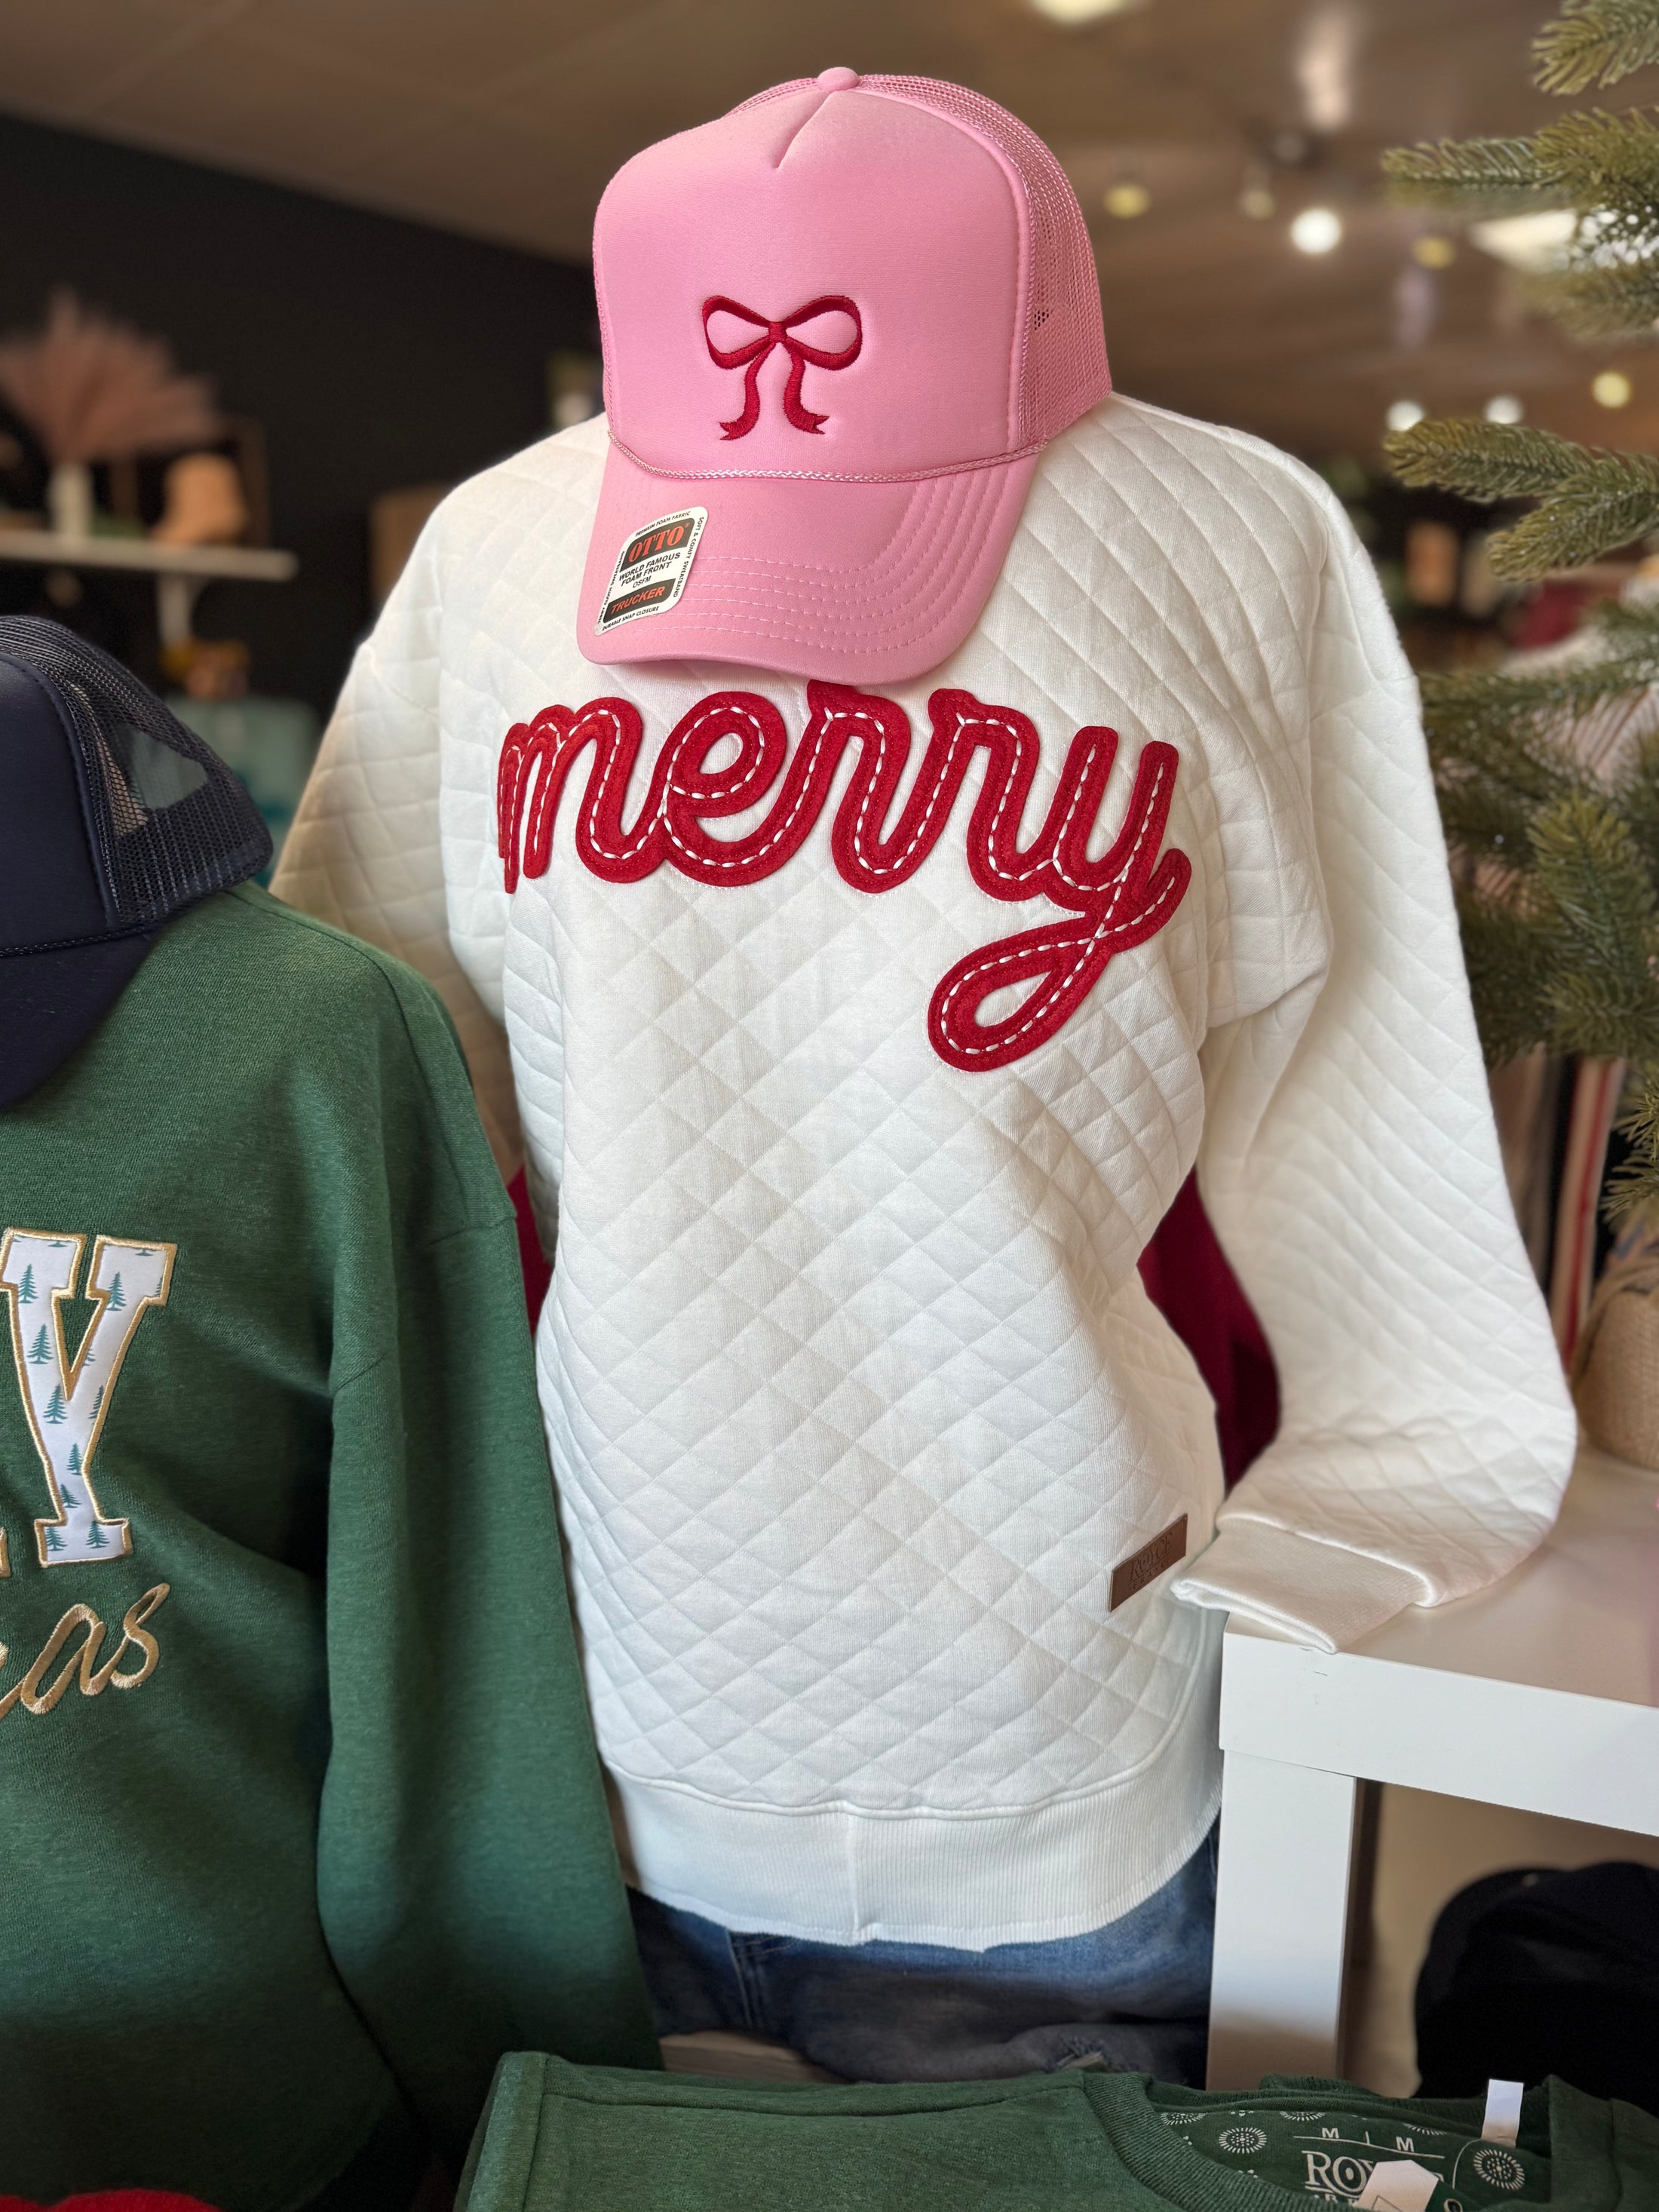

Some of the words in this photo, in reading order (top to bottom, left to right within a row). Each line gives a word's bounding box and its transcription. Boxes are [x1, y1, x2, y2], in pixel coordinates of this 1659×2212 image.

[655, 517, 670, 526] FOAM
[672, 511, 691, 520] FABRIC
[619, 565, 646, 581] WORLD
[646, 552, 681, 568] FAMOUS
[621, 572, 642, 587] FOAM
[643, 561, 672, 577] FRONT
[673, 561, 689, 597] SWEATBAND
[633, 575, 652, 588] OSFM
[611, 586, 665, 615] TRUCKER
[602, 618, 621, 631] DURABLE
[621, 612, 636, 621] SNAP
[636, 606, 660, 616] CLOSURE
[497, 680, 1191, 1072] merry
[1321, 2127, 1340, 2139] M
[1396, 2136, 1415, 2152] M
